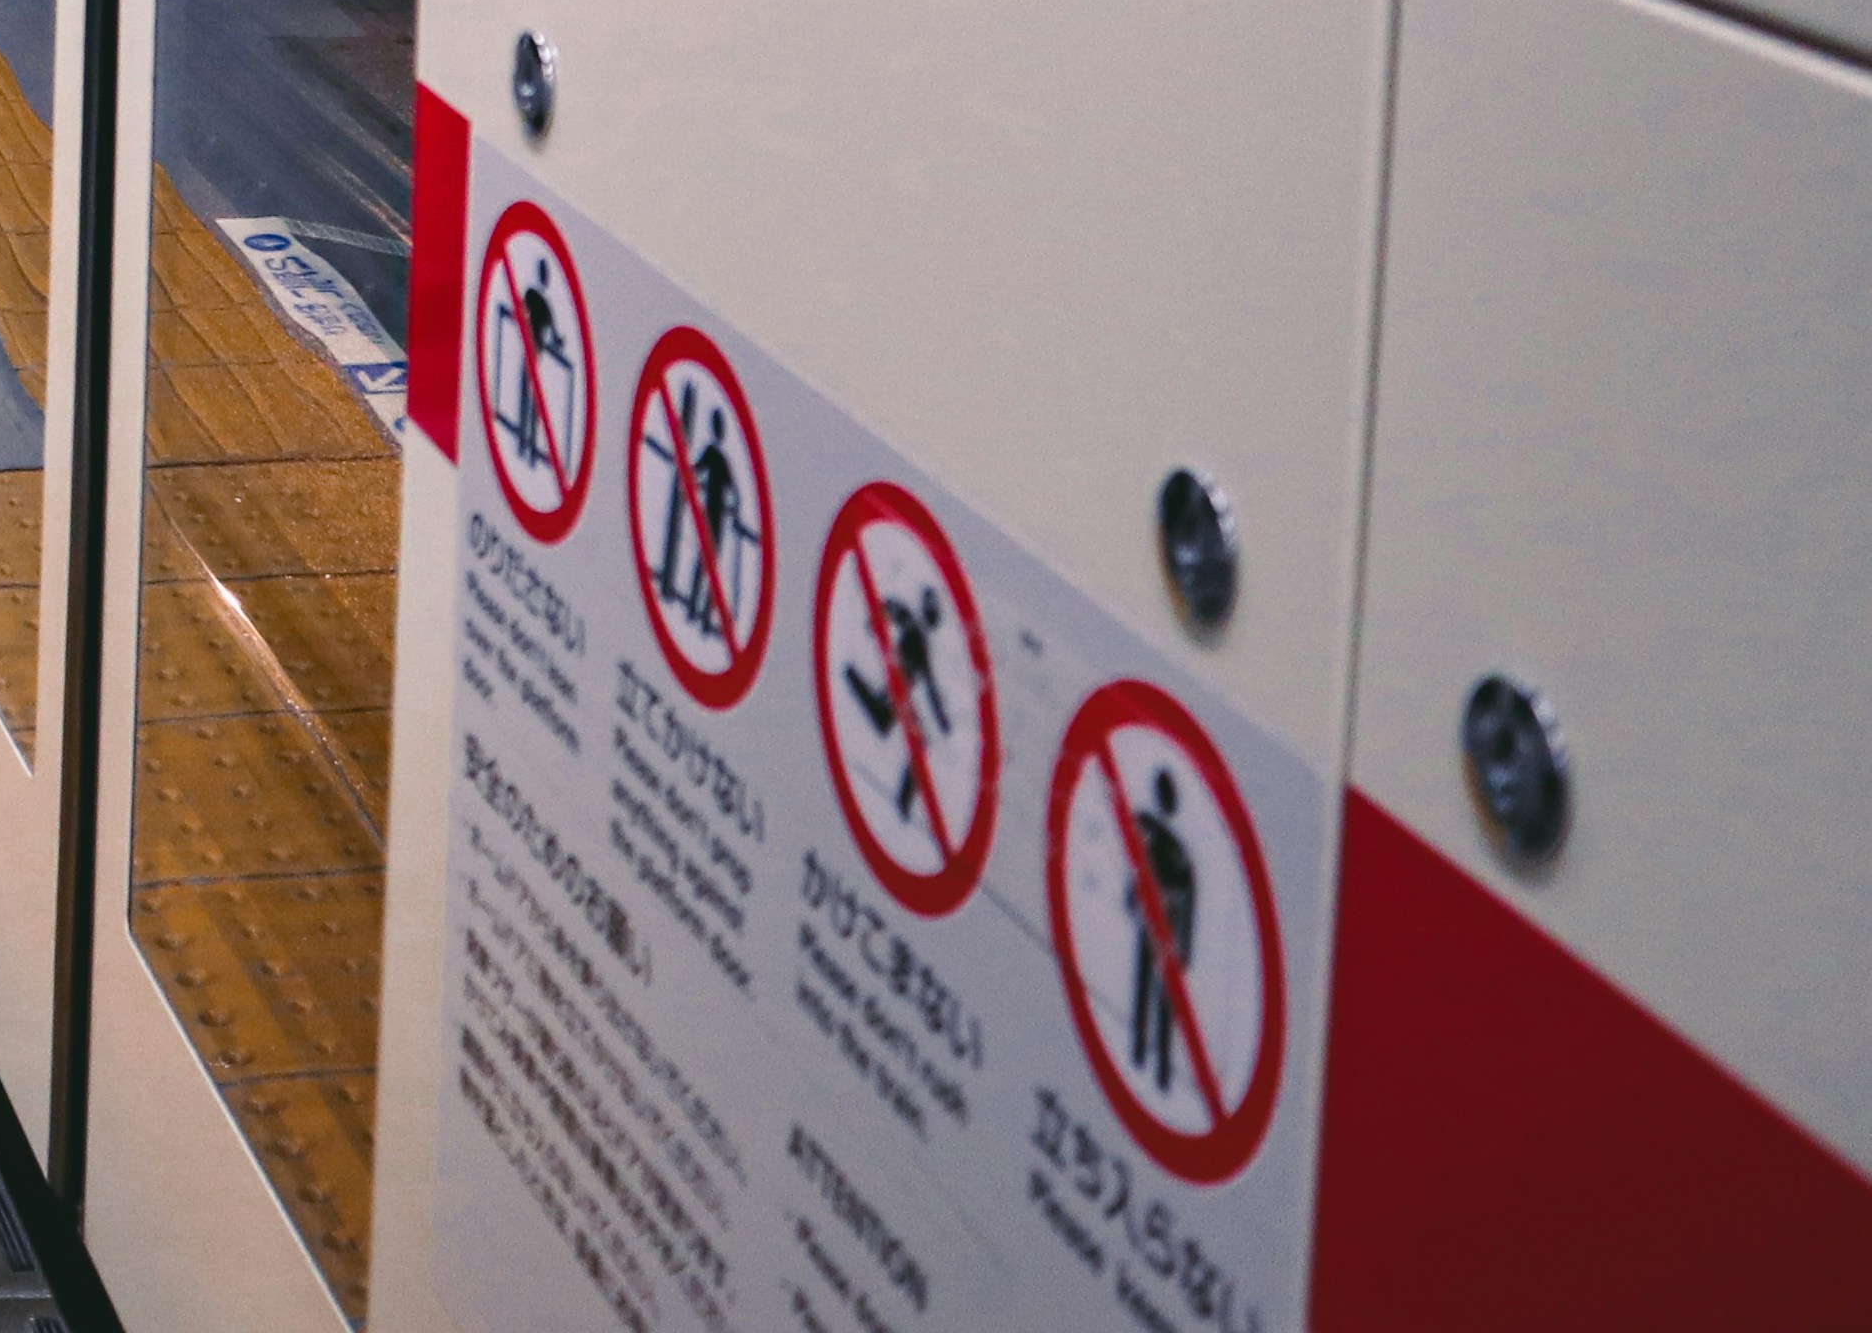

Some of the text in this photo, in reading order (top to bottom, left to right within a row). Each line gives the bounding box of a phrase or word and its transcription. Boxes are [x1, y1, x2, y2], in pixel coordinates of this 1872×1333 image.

[470, 512, 586, 659] のりださない
[614, 724, 662, 793] Please
[617, 657, 765, 844] 立てかけない
[637, 852, 708, 942] platform
[799, 921, 858, 1004] Please
[802, 846, 985, 1073] かけこまない
[786, 1122, 929, 1314] ATTENTION
[1027, 1165, 1106, 1277] Please
[1031, 1085, 1264, 1333] 立ち入らない
